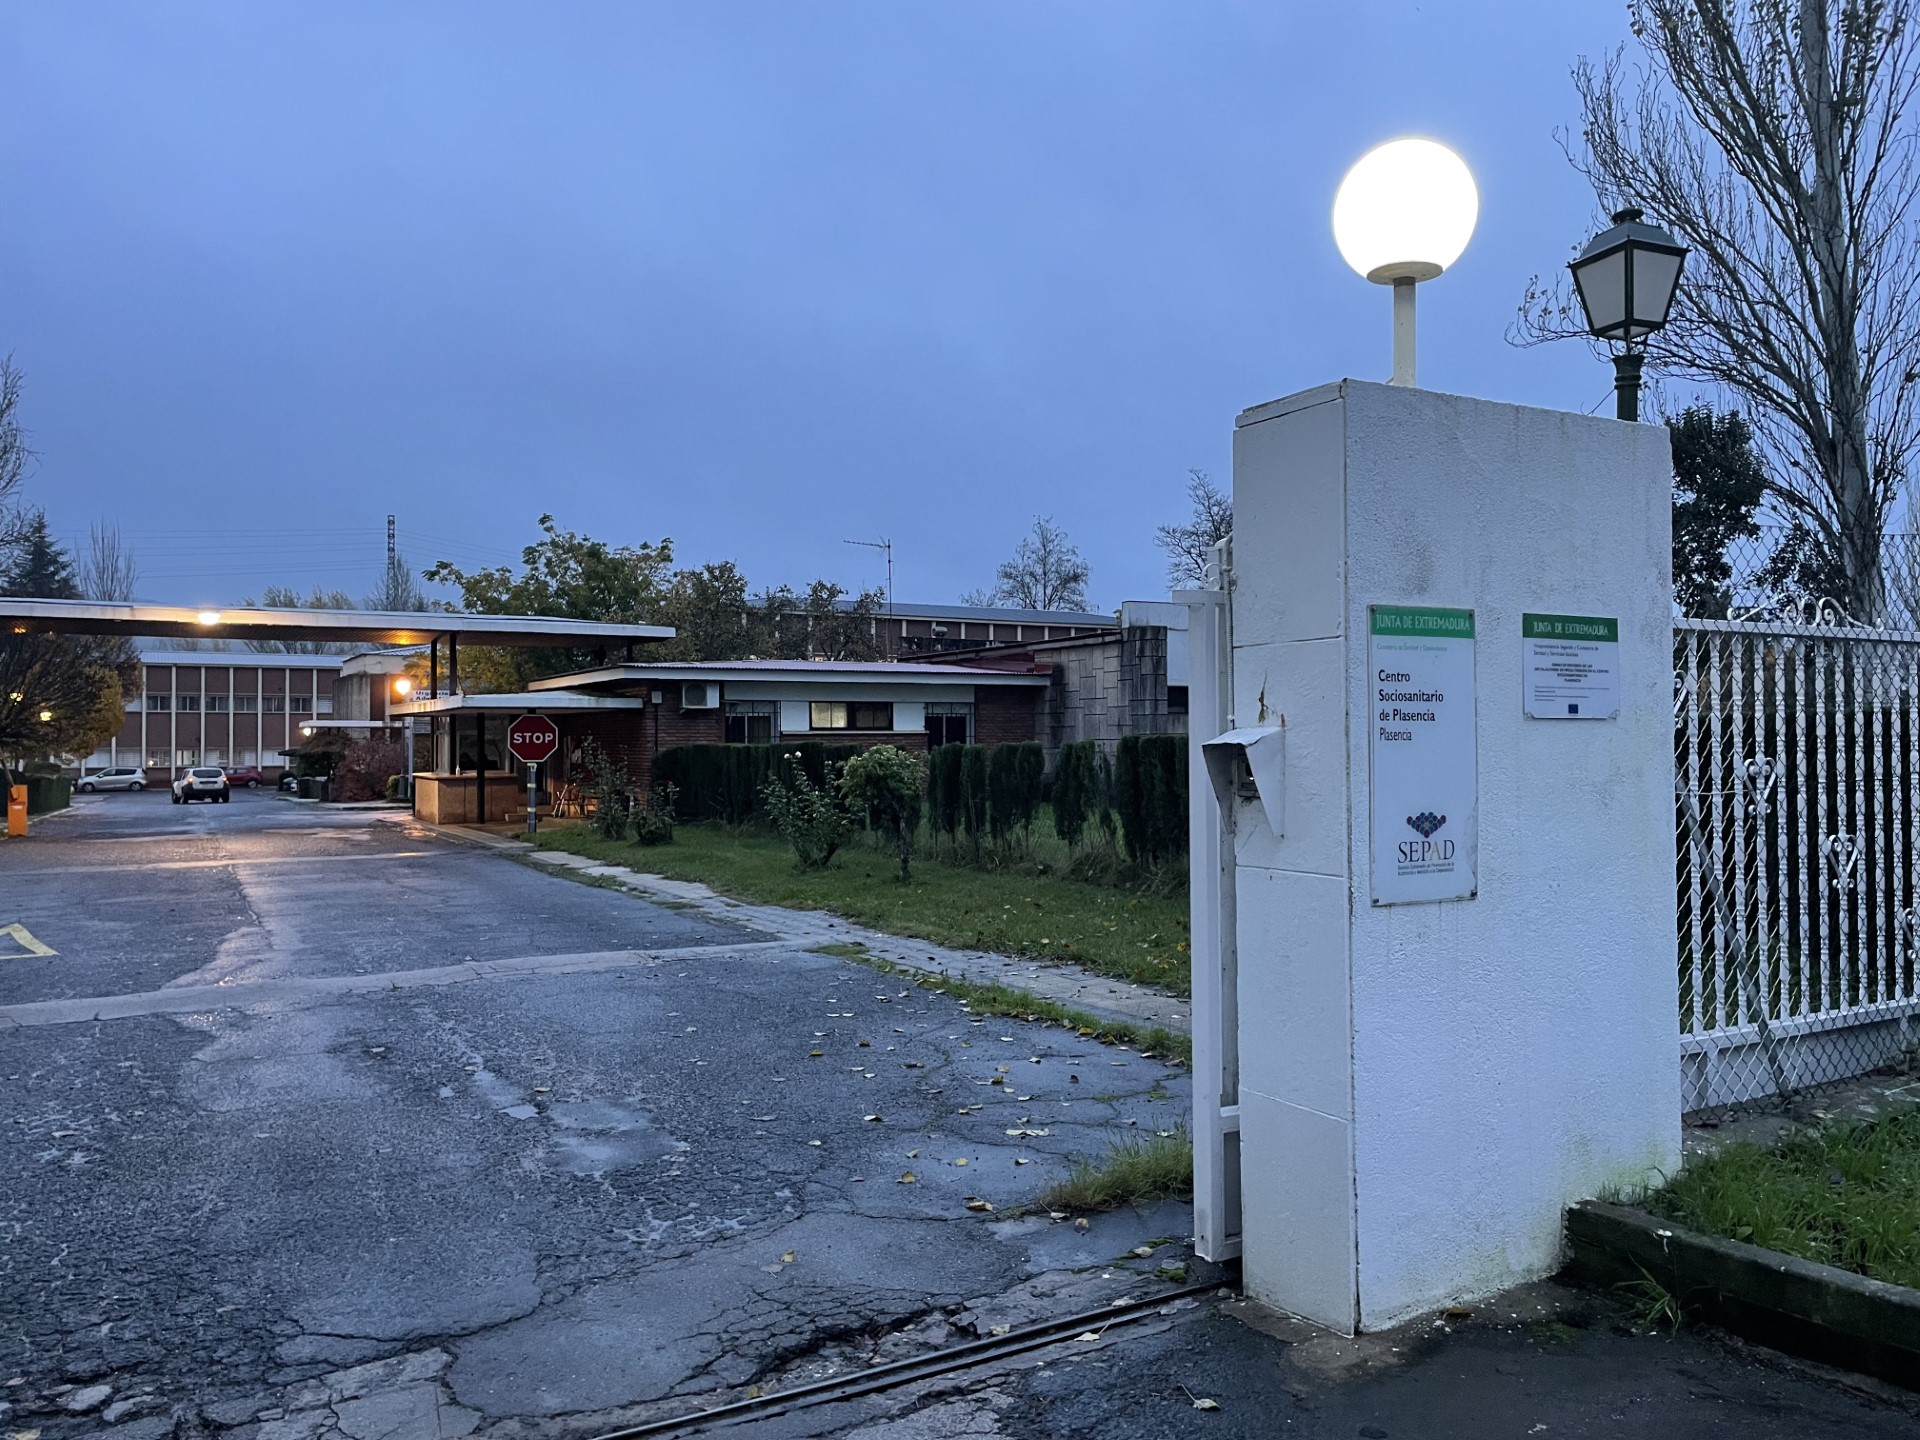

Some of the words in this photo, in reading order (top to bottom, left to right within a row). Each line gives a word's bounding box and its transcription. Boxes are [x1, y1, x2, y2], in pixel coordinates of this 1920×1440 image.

[1376, 614, 1401, 629] JUNTA
[1403, 616, 1413, 629] DE
[1415, 616, 1470, 631] EXTREMADURA
[1533, 622, 1552, 634] JUNTA
[1554, 622, 1563, 634] DE
[1565, 623, 1609, 636] EXTREMADURA
[1378, 669, 1411, 683] Centro
[1378, 689, 1444, 703] Sociosanitario
[1379, 709, 1390, 722] de
[1393, 708, 1435, 722] Plasencia
[513, 732, 554, 744] STOP
[1379, 727, 1412, 742] Plasencia
[1397, 839, 1455, 864] SEPAD
